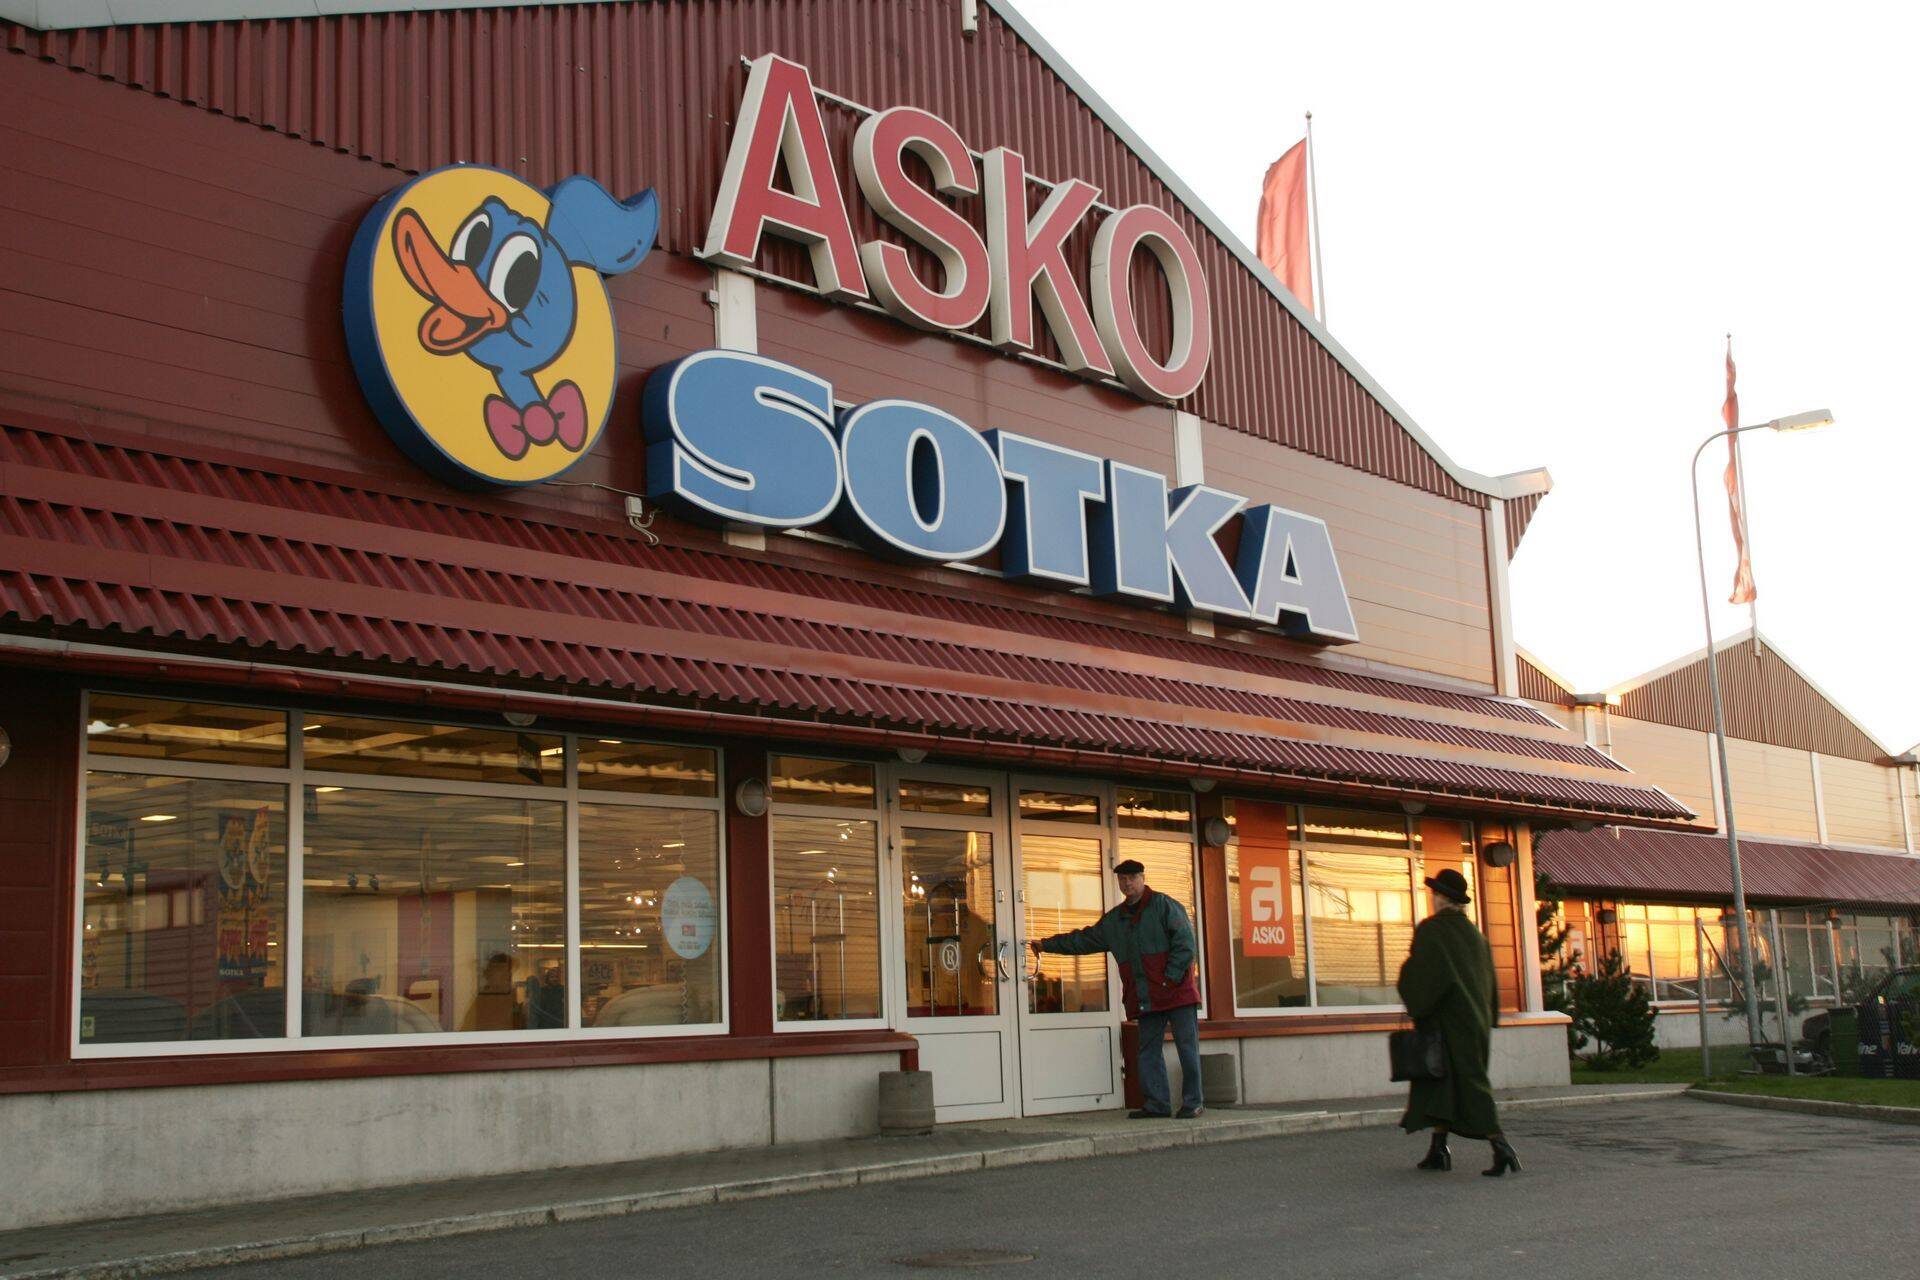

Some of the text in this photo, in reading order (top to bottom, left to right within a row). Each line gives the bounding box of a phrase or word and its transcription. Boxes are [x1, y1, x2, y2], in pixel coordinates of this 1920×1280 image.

[703, 53, 1211, 399] ASKO
[644, 349, 1359, 643] SOTKA
[1252, 926, 1285, 944] ASKO
